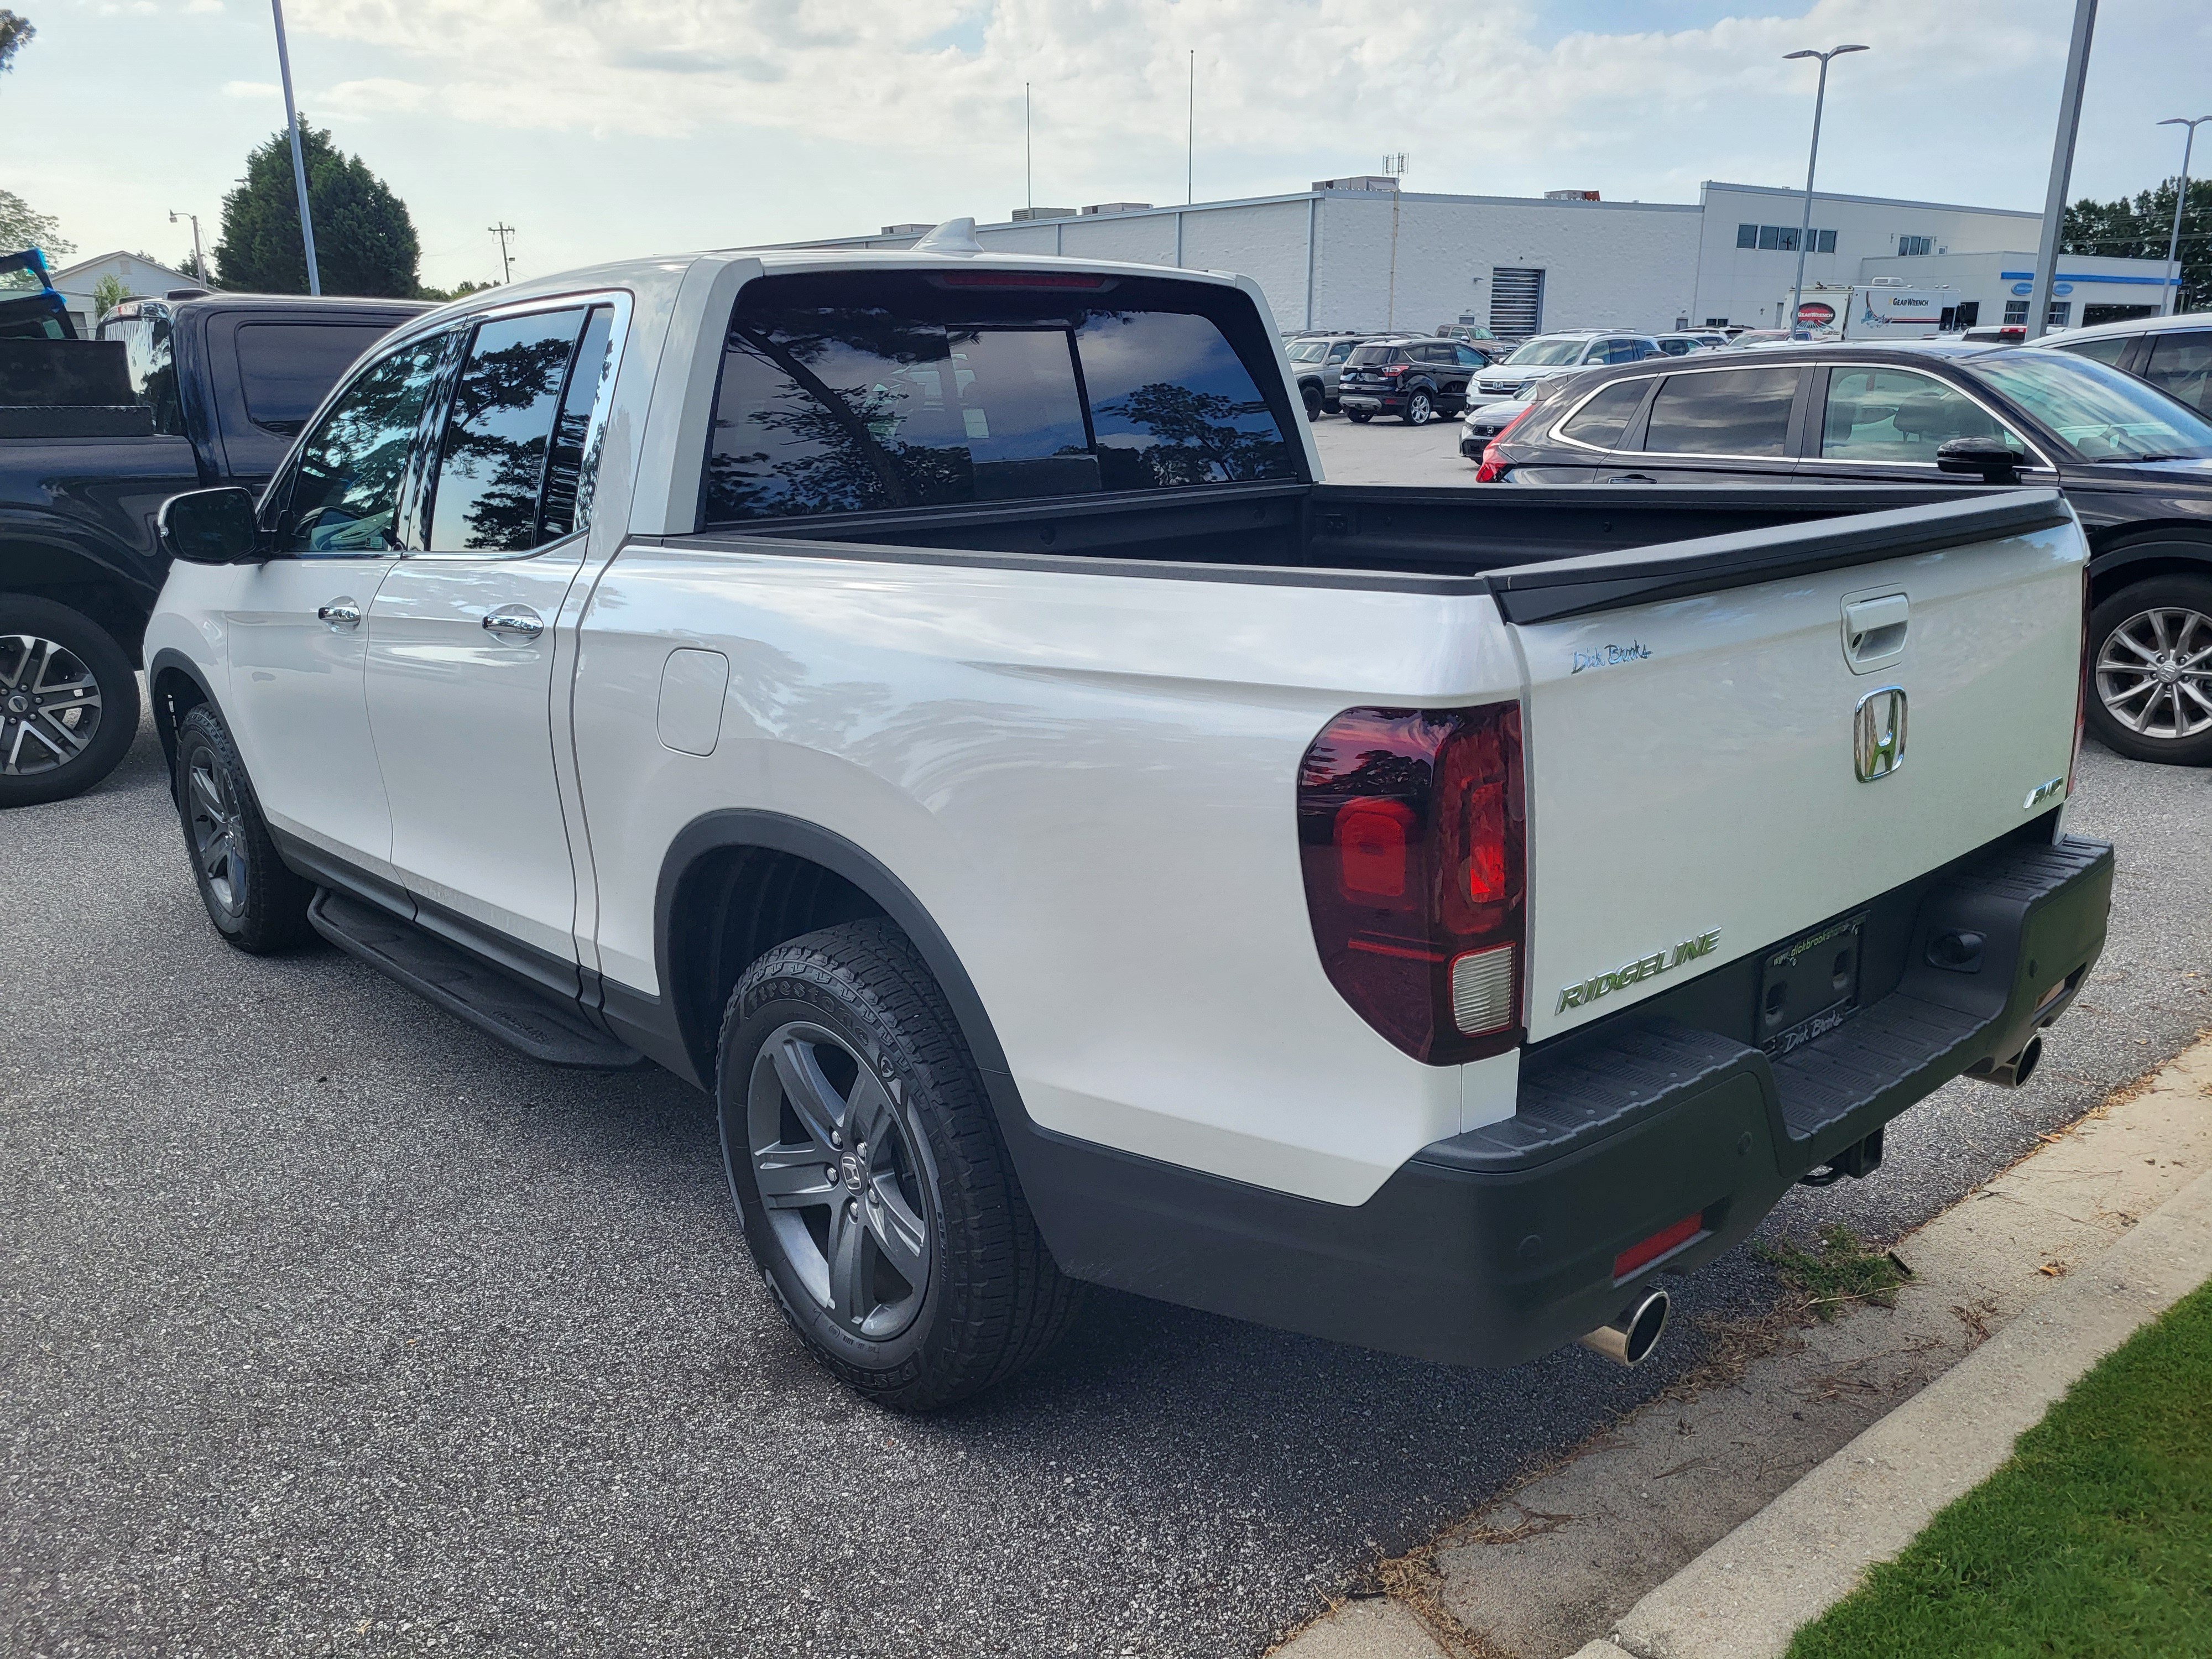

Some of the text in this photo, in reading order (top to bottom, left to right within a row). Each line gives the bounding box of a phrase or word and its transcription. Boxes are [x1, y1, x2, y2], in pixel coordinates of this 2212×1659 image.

[1571, 638, 1653, 675] Dick Brooks
[1554, 926, 1722, 1016] RIDGELINE
[748, 980, 869, 1046] Firestone
[1783, 1010, 1843, 1053] Dick Brooks
